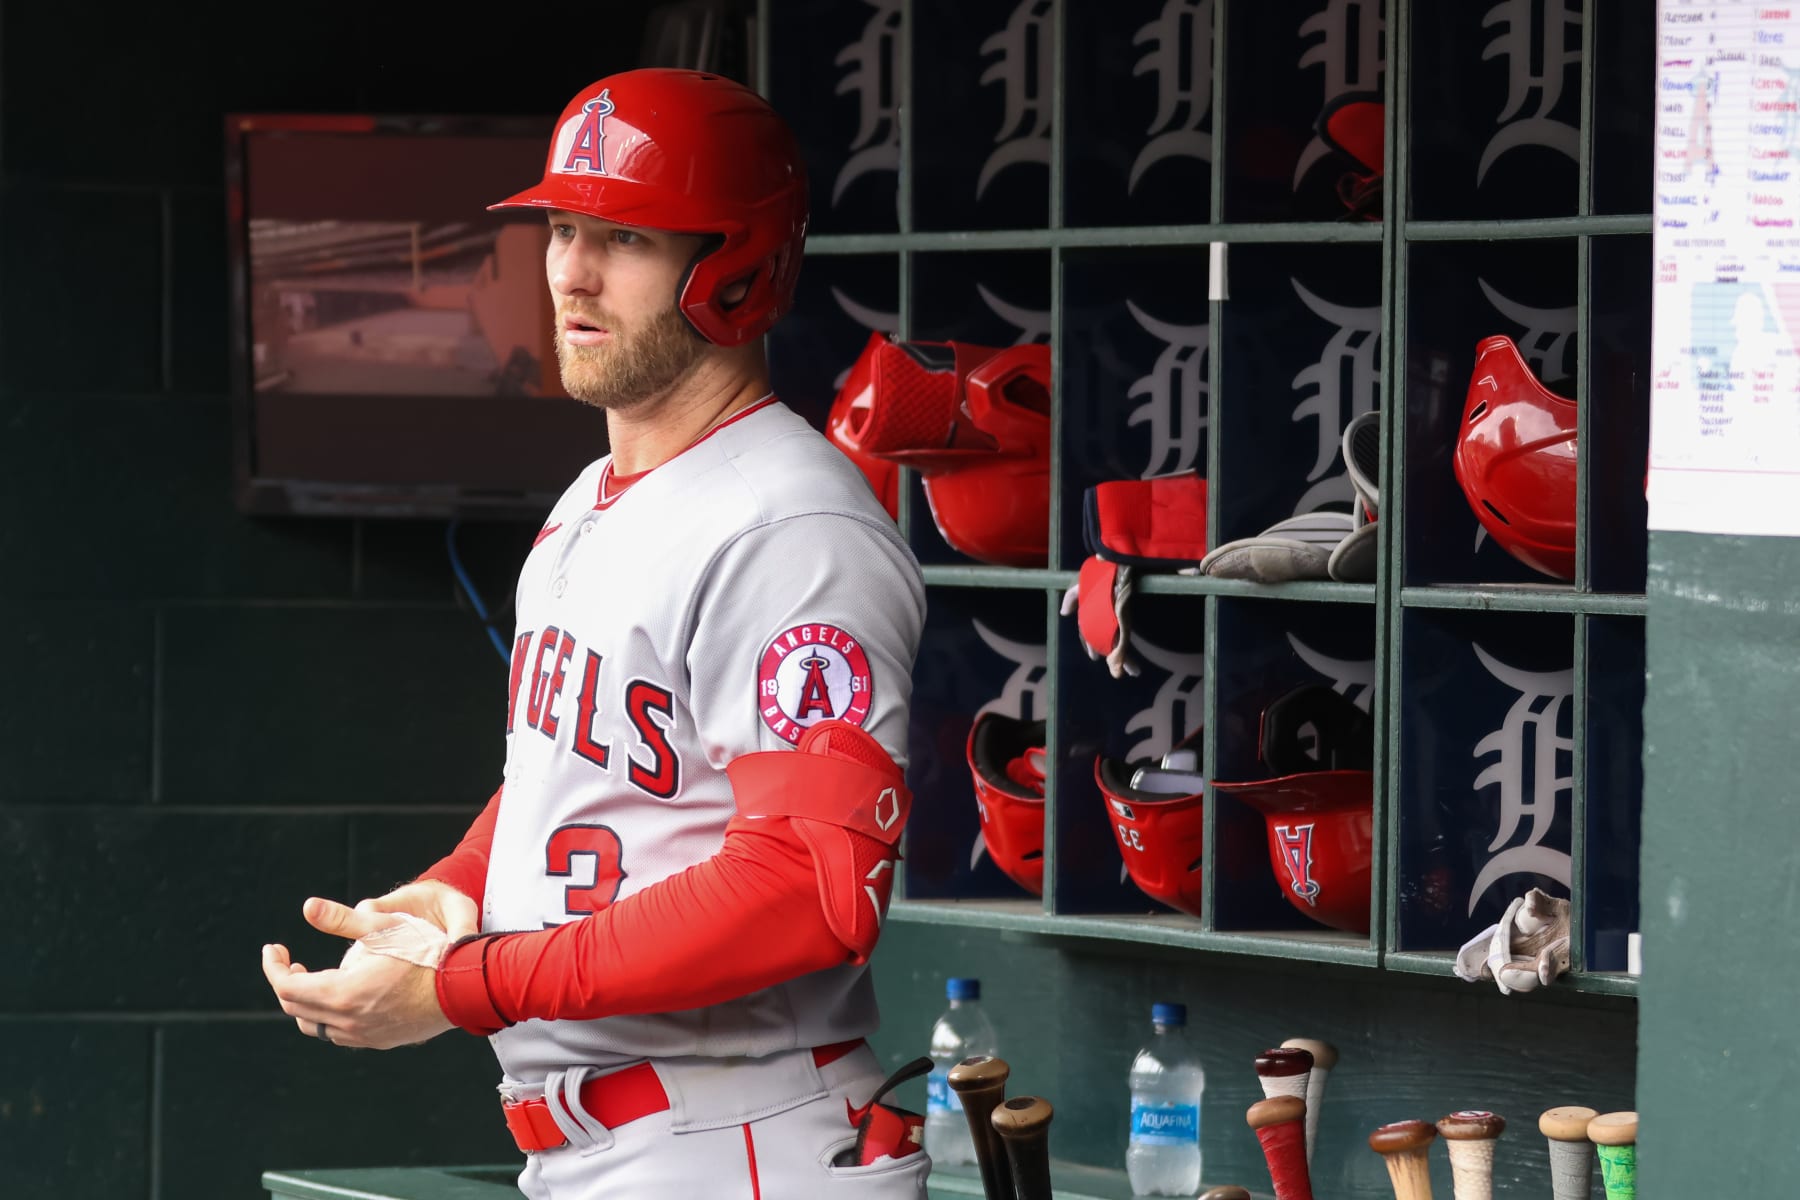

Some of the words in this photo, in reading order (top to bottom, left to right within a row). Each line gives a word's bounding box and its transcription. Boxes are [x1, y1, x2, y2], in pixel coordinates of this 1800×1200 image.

[562, 88, 615, 175] A
[772, 626, 855, 658] ANGELS
[506, 624, 681, 800] NGELS
[760, 678, 778, 697] 19
[851, 675, 868, 693] 61
[795, 647, 836, 720] A
[543, 823, 628, 930] 3
[1140, 1111, 1192, 1130] AQUAFINA
